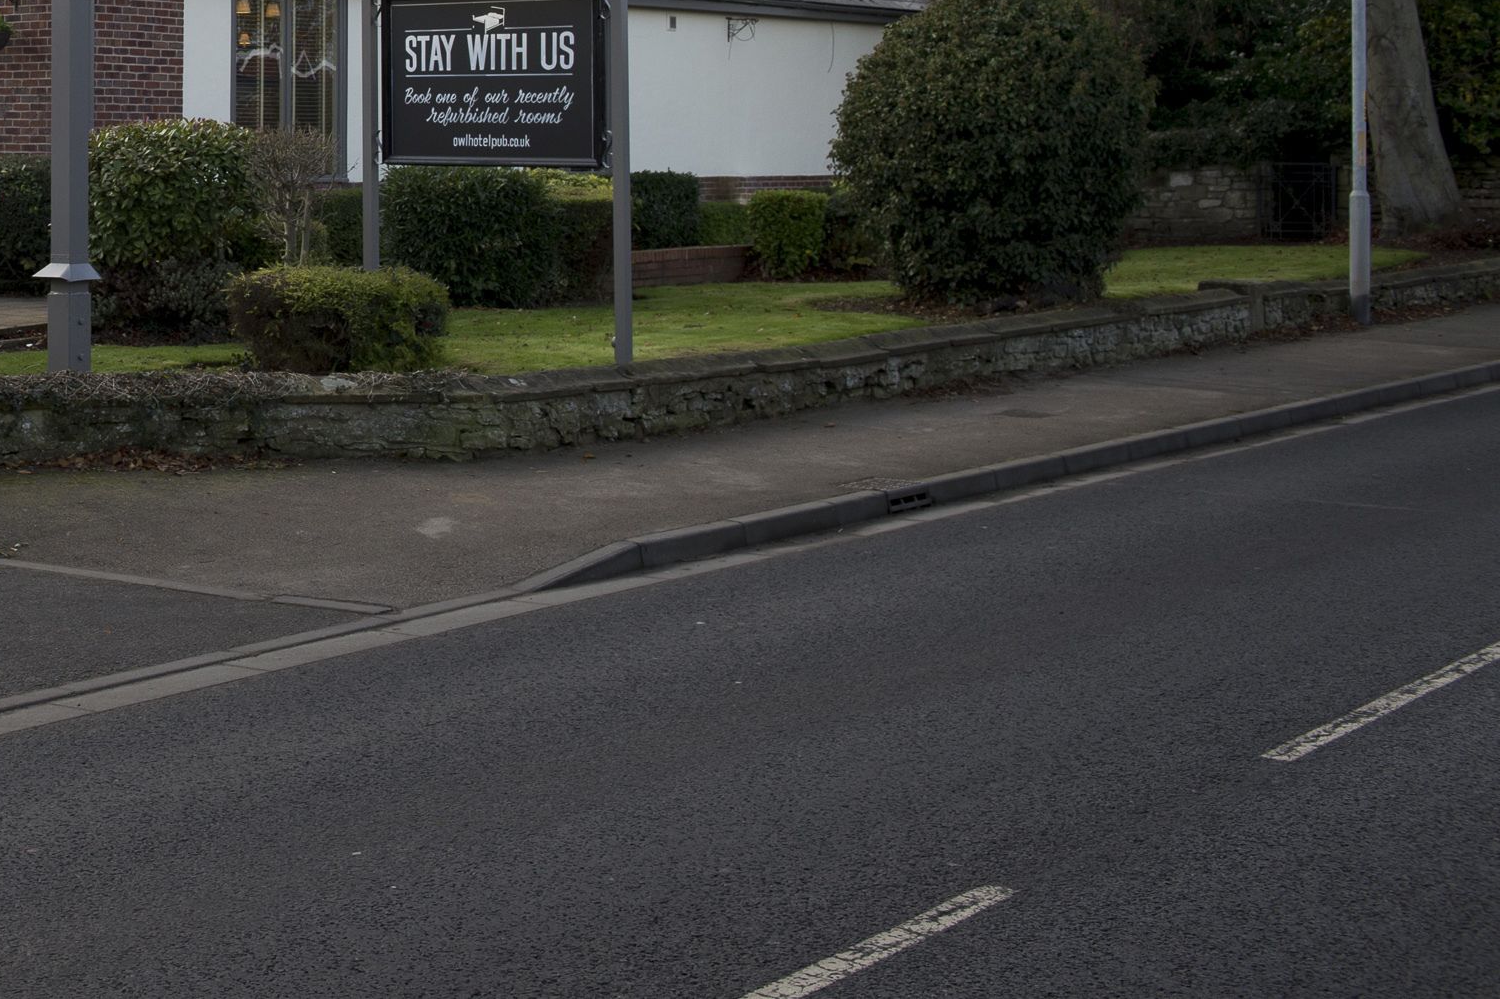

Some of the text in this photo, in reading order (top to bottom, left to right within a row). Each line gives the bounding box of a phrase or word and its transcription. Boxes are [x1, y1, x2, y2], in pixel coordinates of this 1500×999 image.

[405, 31, 575, 73] STAY WITH US
[404, 85, 575, 110] Book one of our recently
[426, 106, 564, 126] refurbished rooms
[452, 134, 531, 149] owlhotelpub.co.uk
